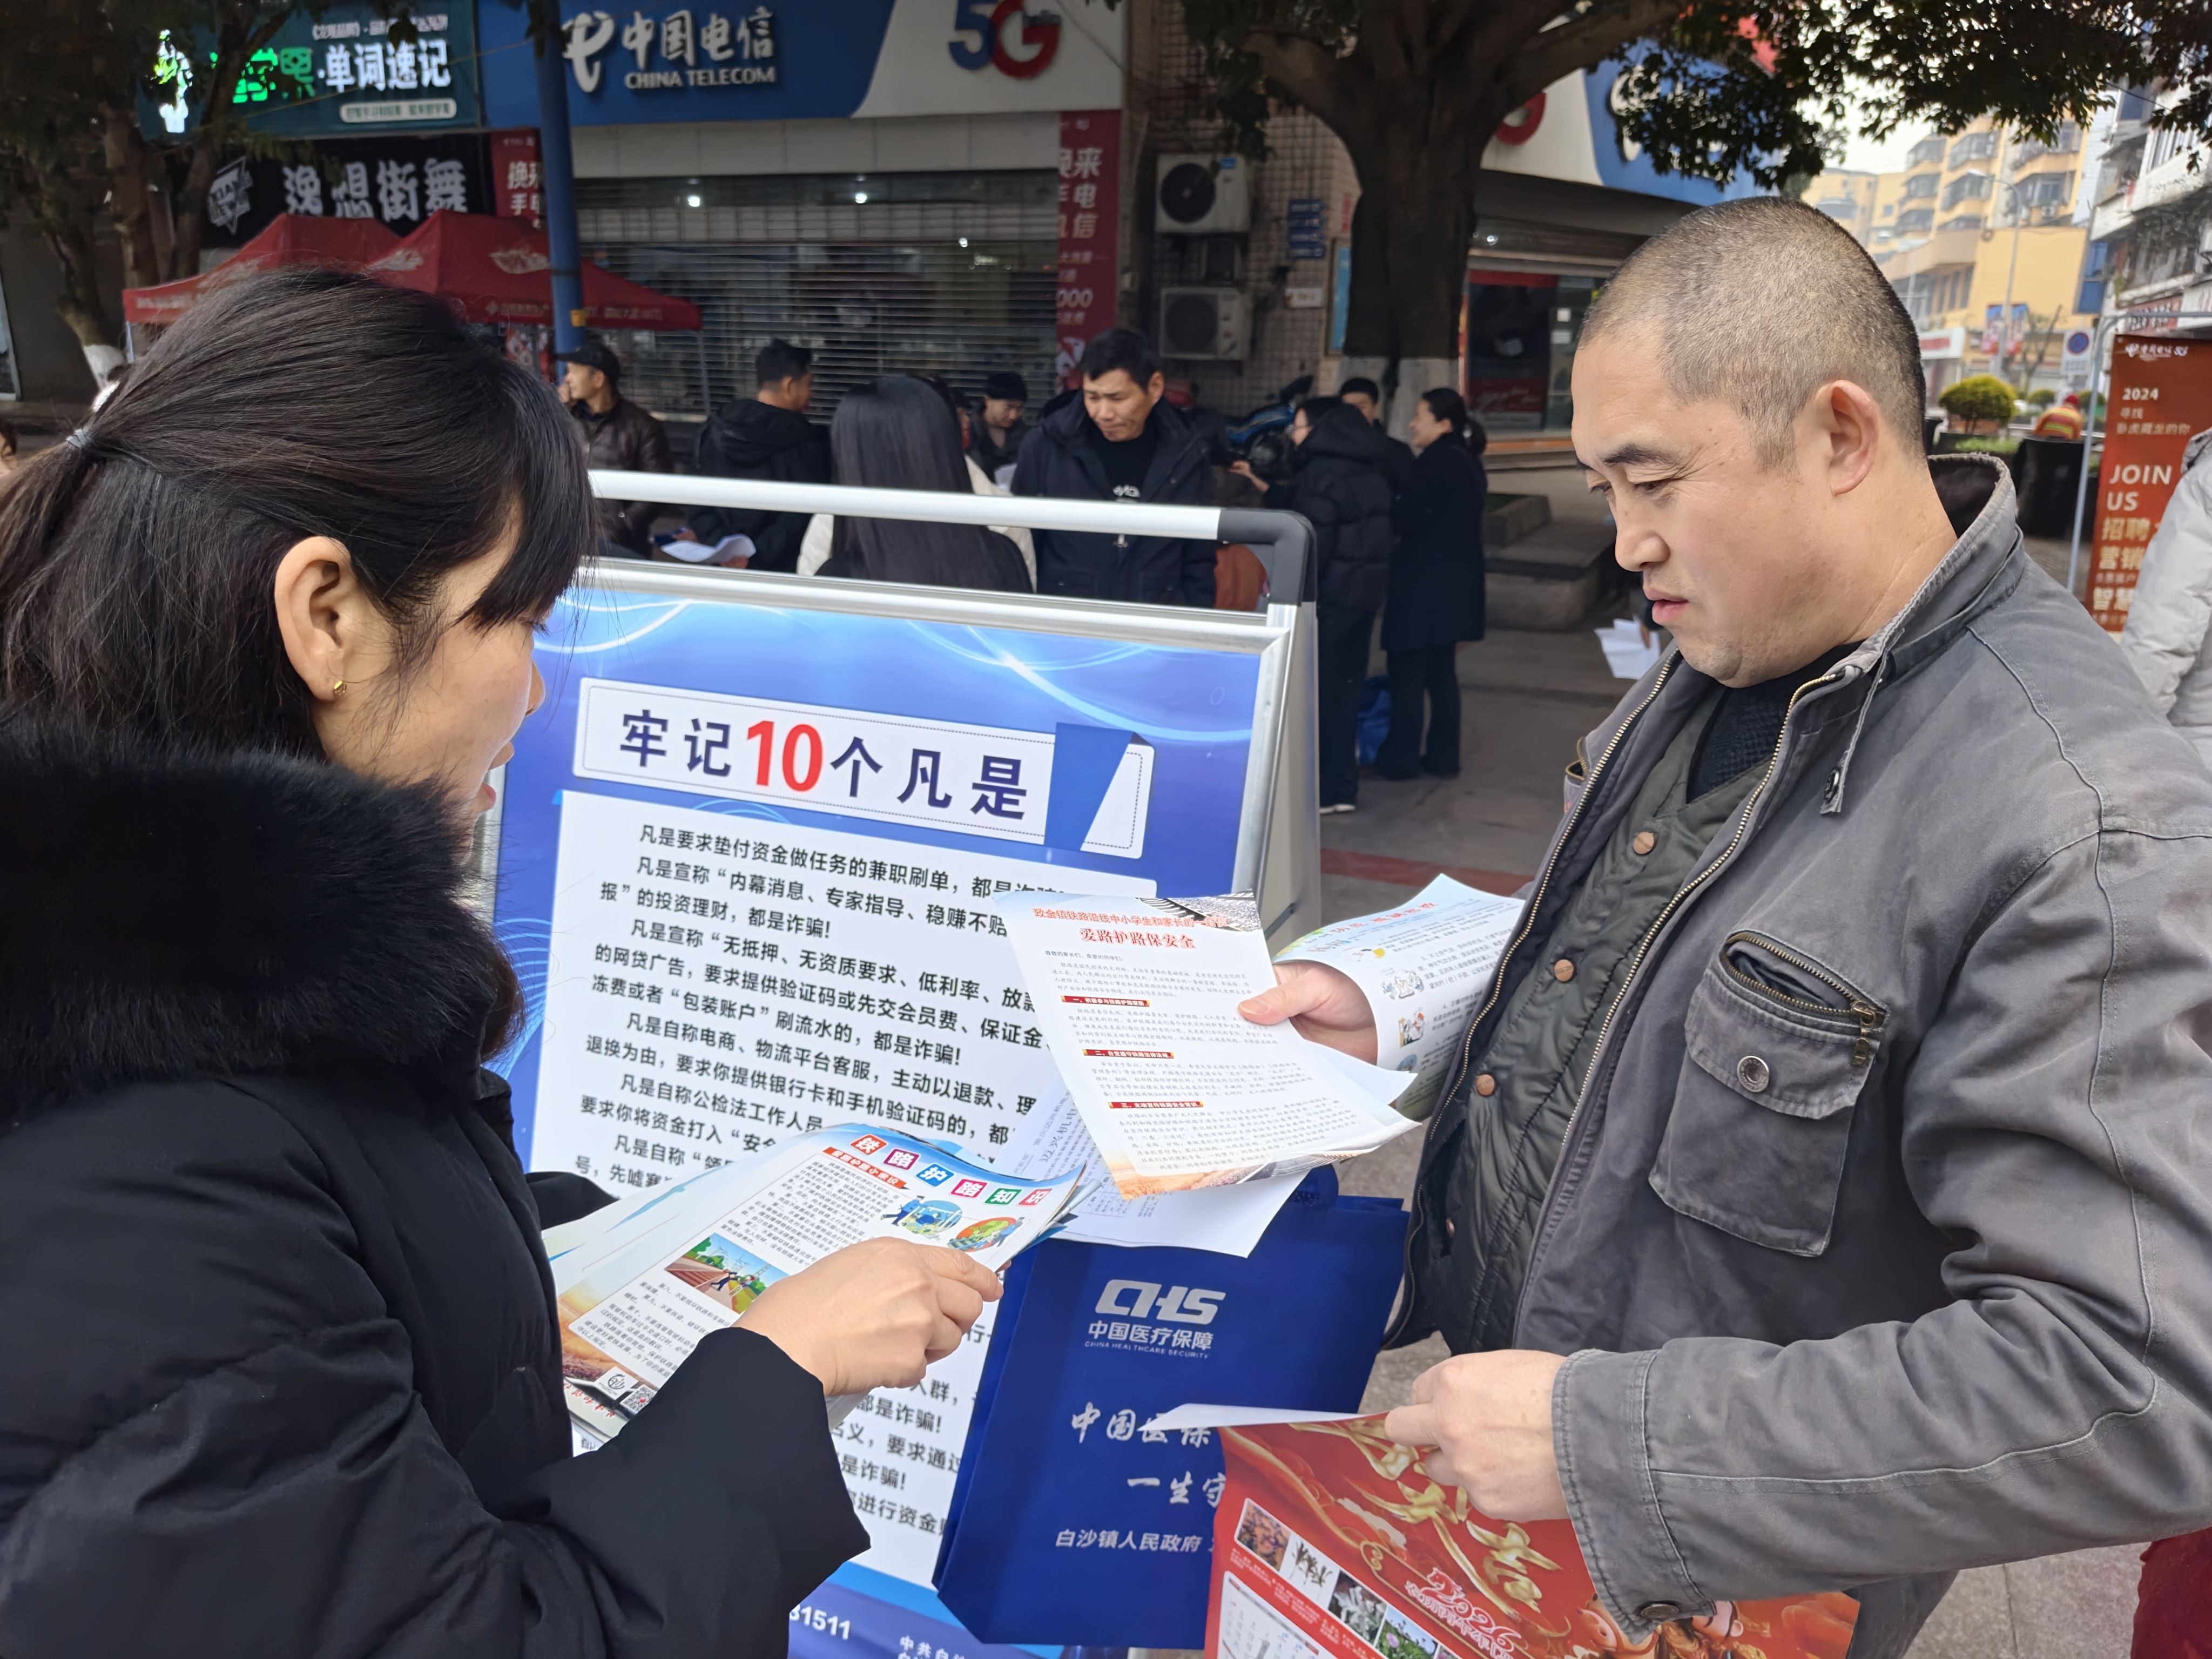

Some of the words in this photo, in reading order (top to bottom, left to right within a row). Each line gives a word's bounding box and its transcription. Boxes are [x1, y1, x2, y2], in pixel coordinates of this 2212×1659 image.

[622, 6, 774, 70] 中国电信
[326, 38, 451, 93] 单词速记
[624, 69, 683, 90] CHINA
[686, 66, 777, 88] TELECOM
[2122, 387, 2159, 401] 2024
[2109, 464, 2172, 485] JOIN
[2107, 491, 2139, 511] US
[619, 708, 1029, 820] 牢记10个凡是
[639, 824, 1056, 899] 凡是要求垫付资金做任务的兼职刷单，都是
[1080, 927, 1197, 949] 爱路护路保安全
[575, 1155, 673, 1188] 号，先嘘寒
[855, 1137, 1050, 1205] 铁路护路知识
[1088, 1320, 1214, 1351] 中国医疗保障
[1168, 1350, 1209, 1359] SECURITY
[1055, 1529, 1203, 1553] 白沙镇人民政府
